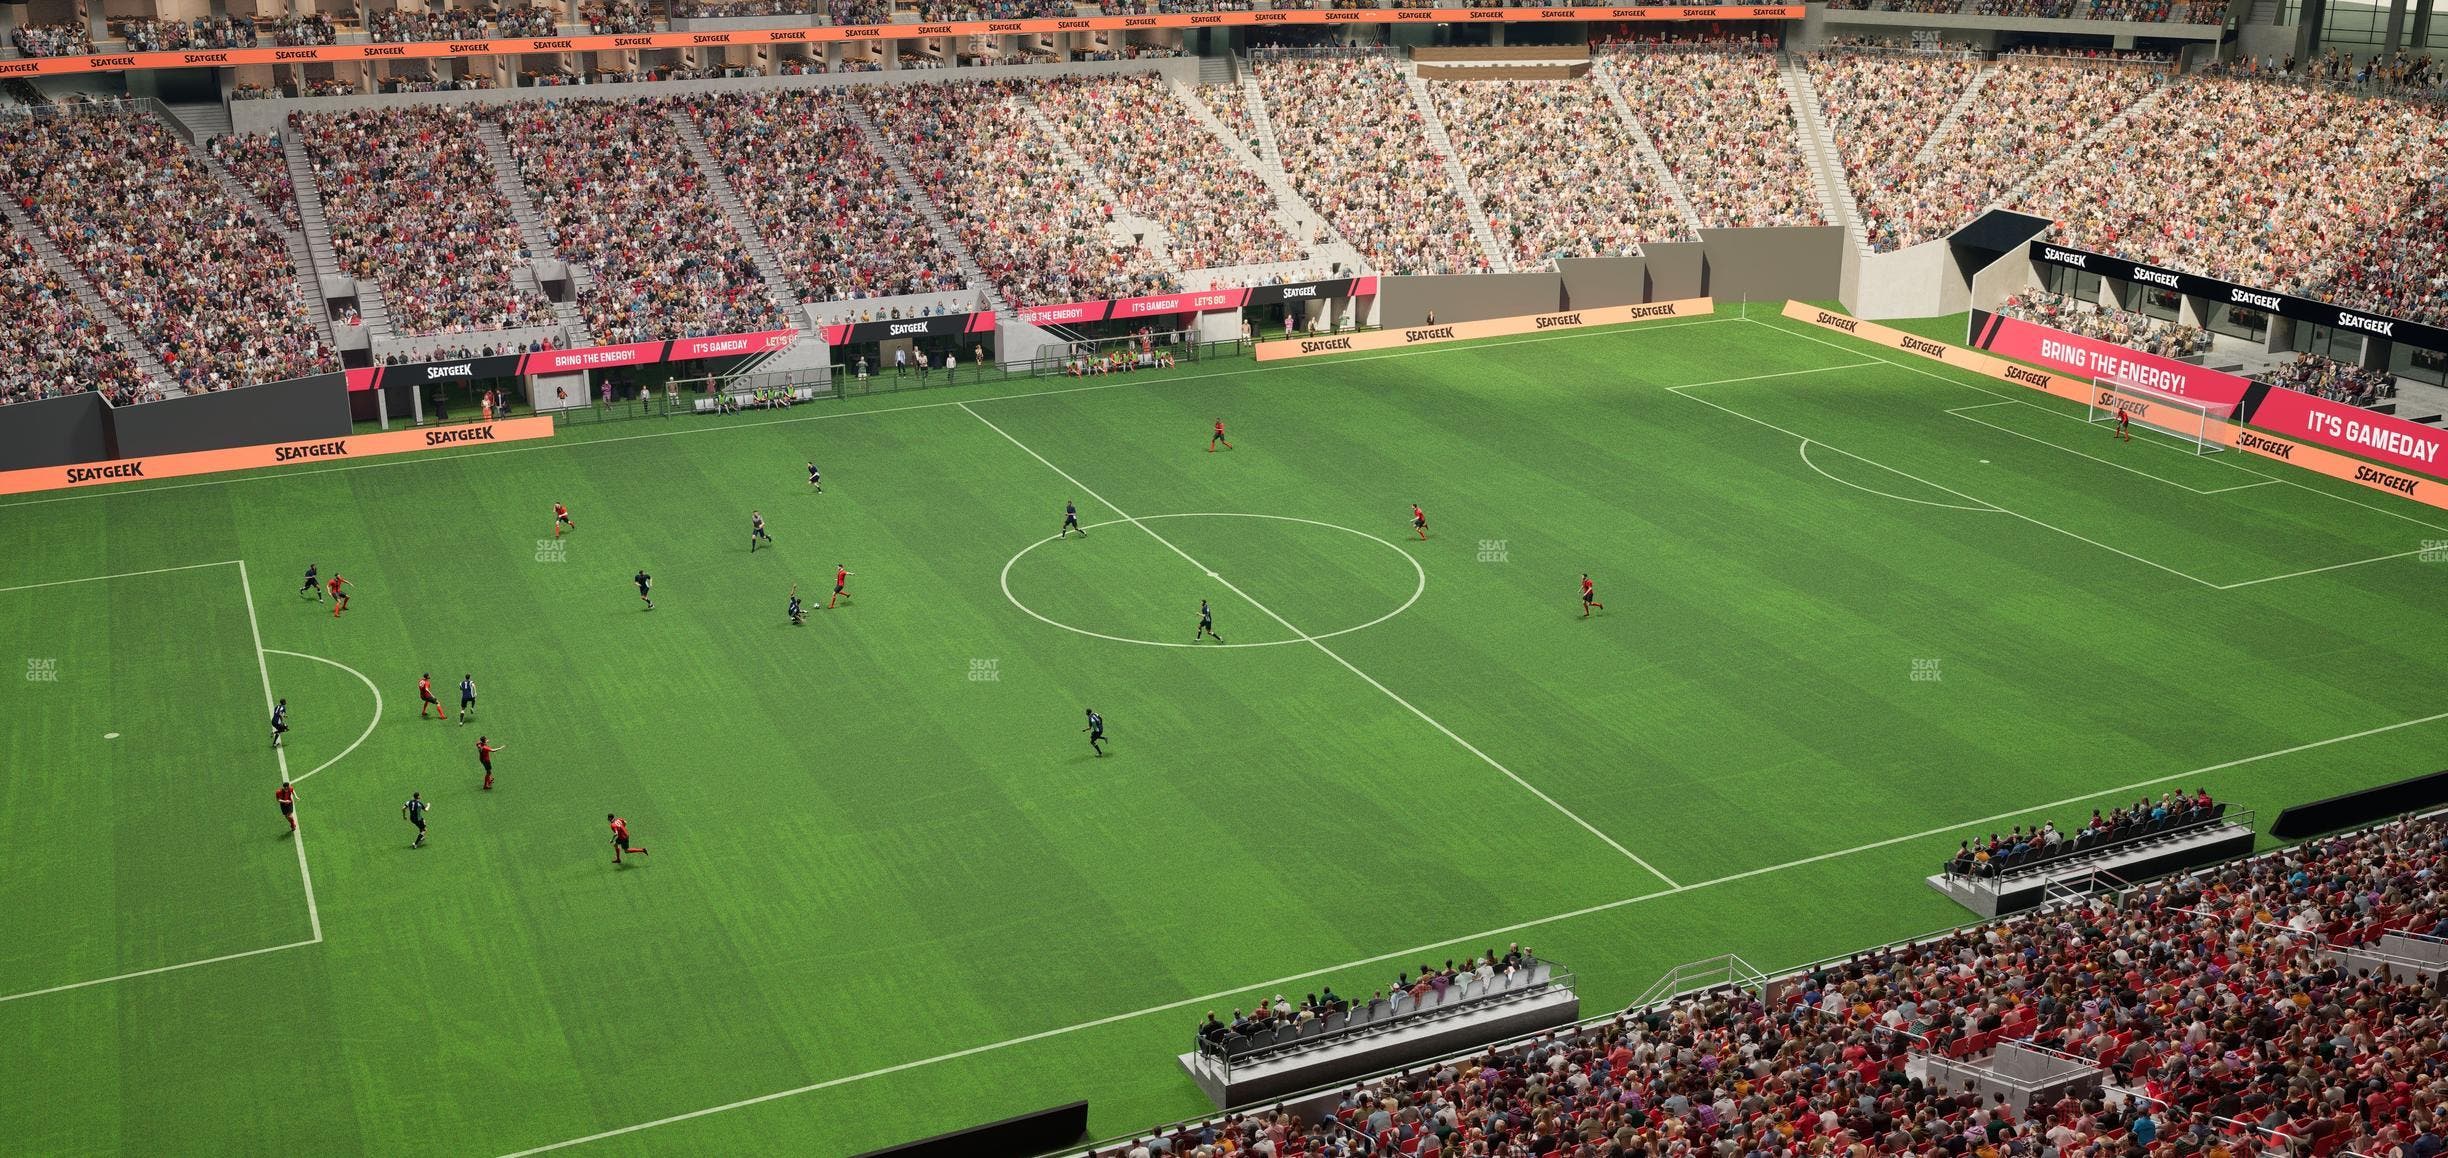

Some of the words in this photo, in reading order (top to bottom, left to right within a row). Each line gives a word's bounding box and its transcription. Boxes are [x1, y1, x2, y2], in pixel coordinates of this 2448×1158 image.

[0, 63, 39, 73] EATGEEK
[90, 56, 136, 68] SEATGEEK
[184, 53, 228, 65] SEATGEEK
[275, 49, 318, 60] SEATGEEK
[363, 46, 405, 57] SEATGEEK
[449, 43, 490, 53] SEATGEEK
[533, 40, 572, 50] SEATGEEK
[614, 36, 652, 47] SEATGEEK
[693, 33, 730, 44] SEATGEEK
[770, 31, 806, 41] SEATGEEK
[844, 28, 880, 38] SEATGEEK
[918, 25, 952, 35] SEATGEEK
[988, 22, 1022, 32] SEATGEEK
[1057, 19, 1091, 29] SEATGEEK
[1124, 17, 1158, 27] SEATGEEK
[1189, 15, 1223, 24] SEATGEEK
[1254, 13, 1288, 22] SEATGEEK
[1325, 12, 1360, 21] SEATGEEK
[1398, 11, 1432, 20] SEATGEEK
[1469, 11, 1504, 19] SEATGEEK
[1541, 10, 1575, 18] SEATGEEK
[1612, 9, 1646, 18] SEATGEEK
[1683, 9, 1716, 17] SEATGEEK
[1752, 8, 1786, 16] SEATGEEK
[2044, 247, 2087, 268] SEATGEEK
[2133, 266, 2179, 289] SEATGEEK
[1194, 296, 1212, 307] LET'S
[1213, 295, 1226, 305] GO!
[1283, 286, 1317, 298] SEATGEEK
[2231, 288, 2281, 312] SEATGEEK
[1052, 309, 1083, 319] ENERGY!
[1132, 303, 1145, 312] IT'S
[1146, 299, 1179, 311] GAMEDAY
[1632, 303, 1676, 318] SEATGEEK
[890, 321, 928, 336] SEATGEEK
[1536, 314, 1583, 328] SEATGEEK
[1816, 311, 1858, 334] SEATGEEK
[2338, 311, 2394, 337] SEATGEEK
[1405, 327, 1454, 343] SEATGEEK
[693, 343, 709, 354] IT'S
[710, 339, 748, 353] GAMEDAY
[1301, 337, 1352, 354] SEATGEEK
[1900, 335, 1946, 359] SEATGEEK
[555, 354, 582, 367] BRING
[583, 353, 600, 364] THE
[601, 350, 636, 363] ENERGY!
[2041, 338, 2086, 368] BRING
[2089, 352, 2118, 376] THE
[2119, 359, 2186, 396] ENERGY!
[427, 364, 473, 380] SEATGEEK
[2003, 364, 2052, 389] SEATGEEK
[2097, 392, 2149, 417] SEATGEEK
[426, 426, 494, 446] SEATGEEK
[2235, 431, 2295, 460] SEATGEEK
[2307, 410, 2342, 439] IT'S
[2346, 421, 2440, 464] GAMEDAY
[275, 441, 347, 461] SEATGEEK
[67, 462, 144, 483] SEATGEEK
[2354, 465, 2420, 496] SEATGEEK
